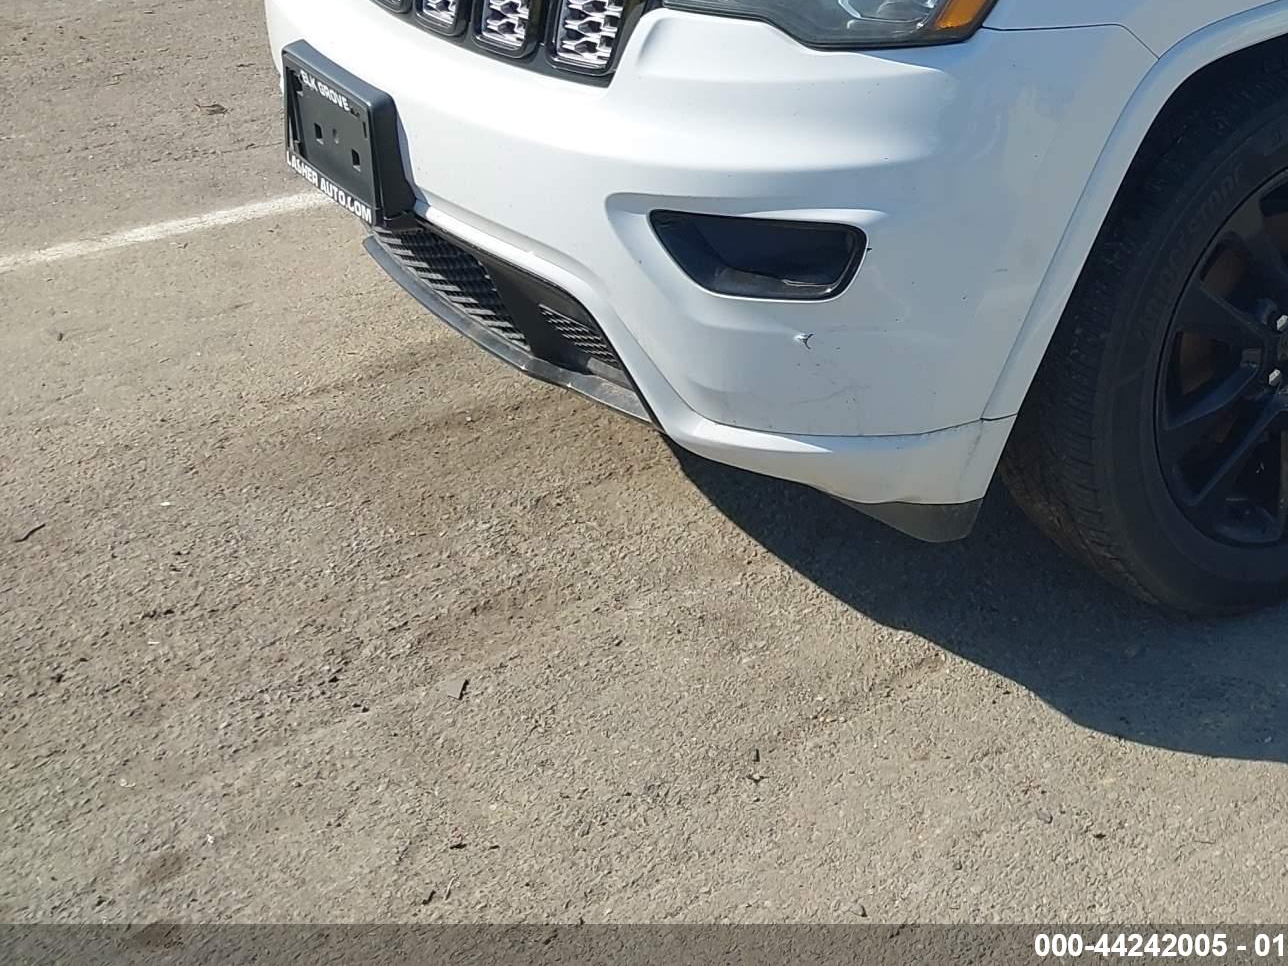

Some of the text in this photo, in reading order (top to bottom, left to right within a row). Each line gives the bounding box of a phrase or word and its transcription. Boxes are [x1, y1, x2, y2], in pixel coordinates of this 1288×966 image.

[317, 81, 351, 112] GROVE
[286, 150, 372, 224] LASHER AUTO.COM
